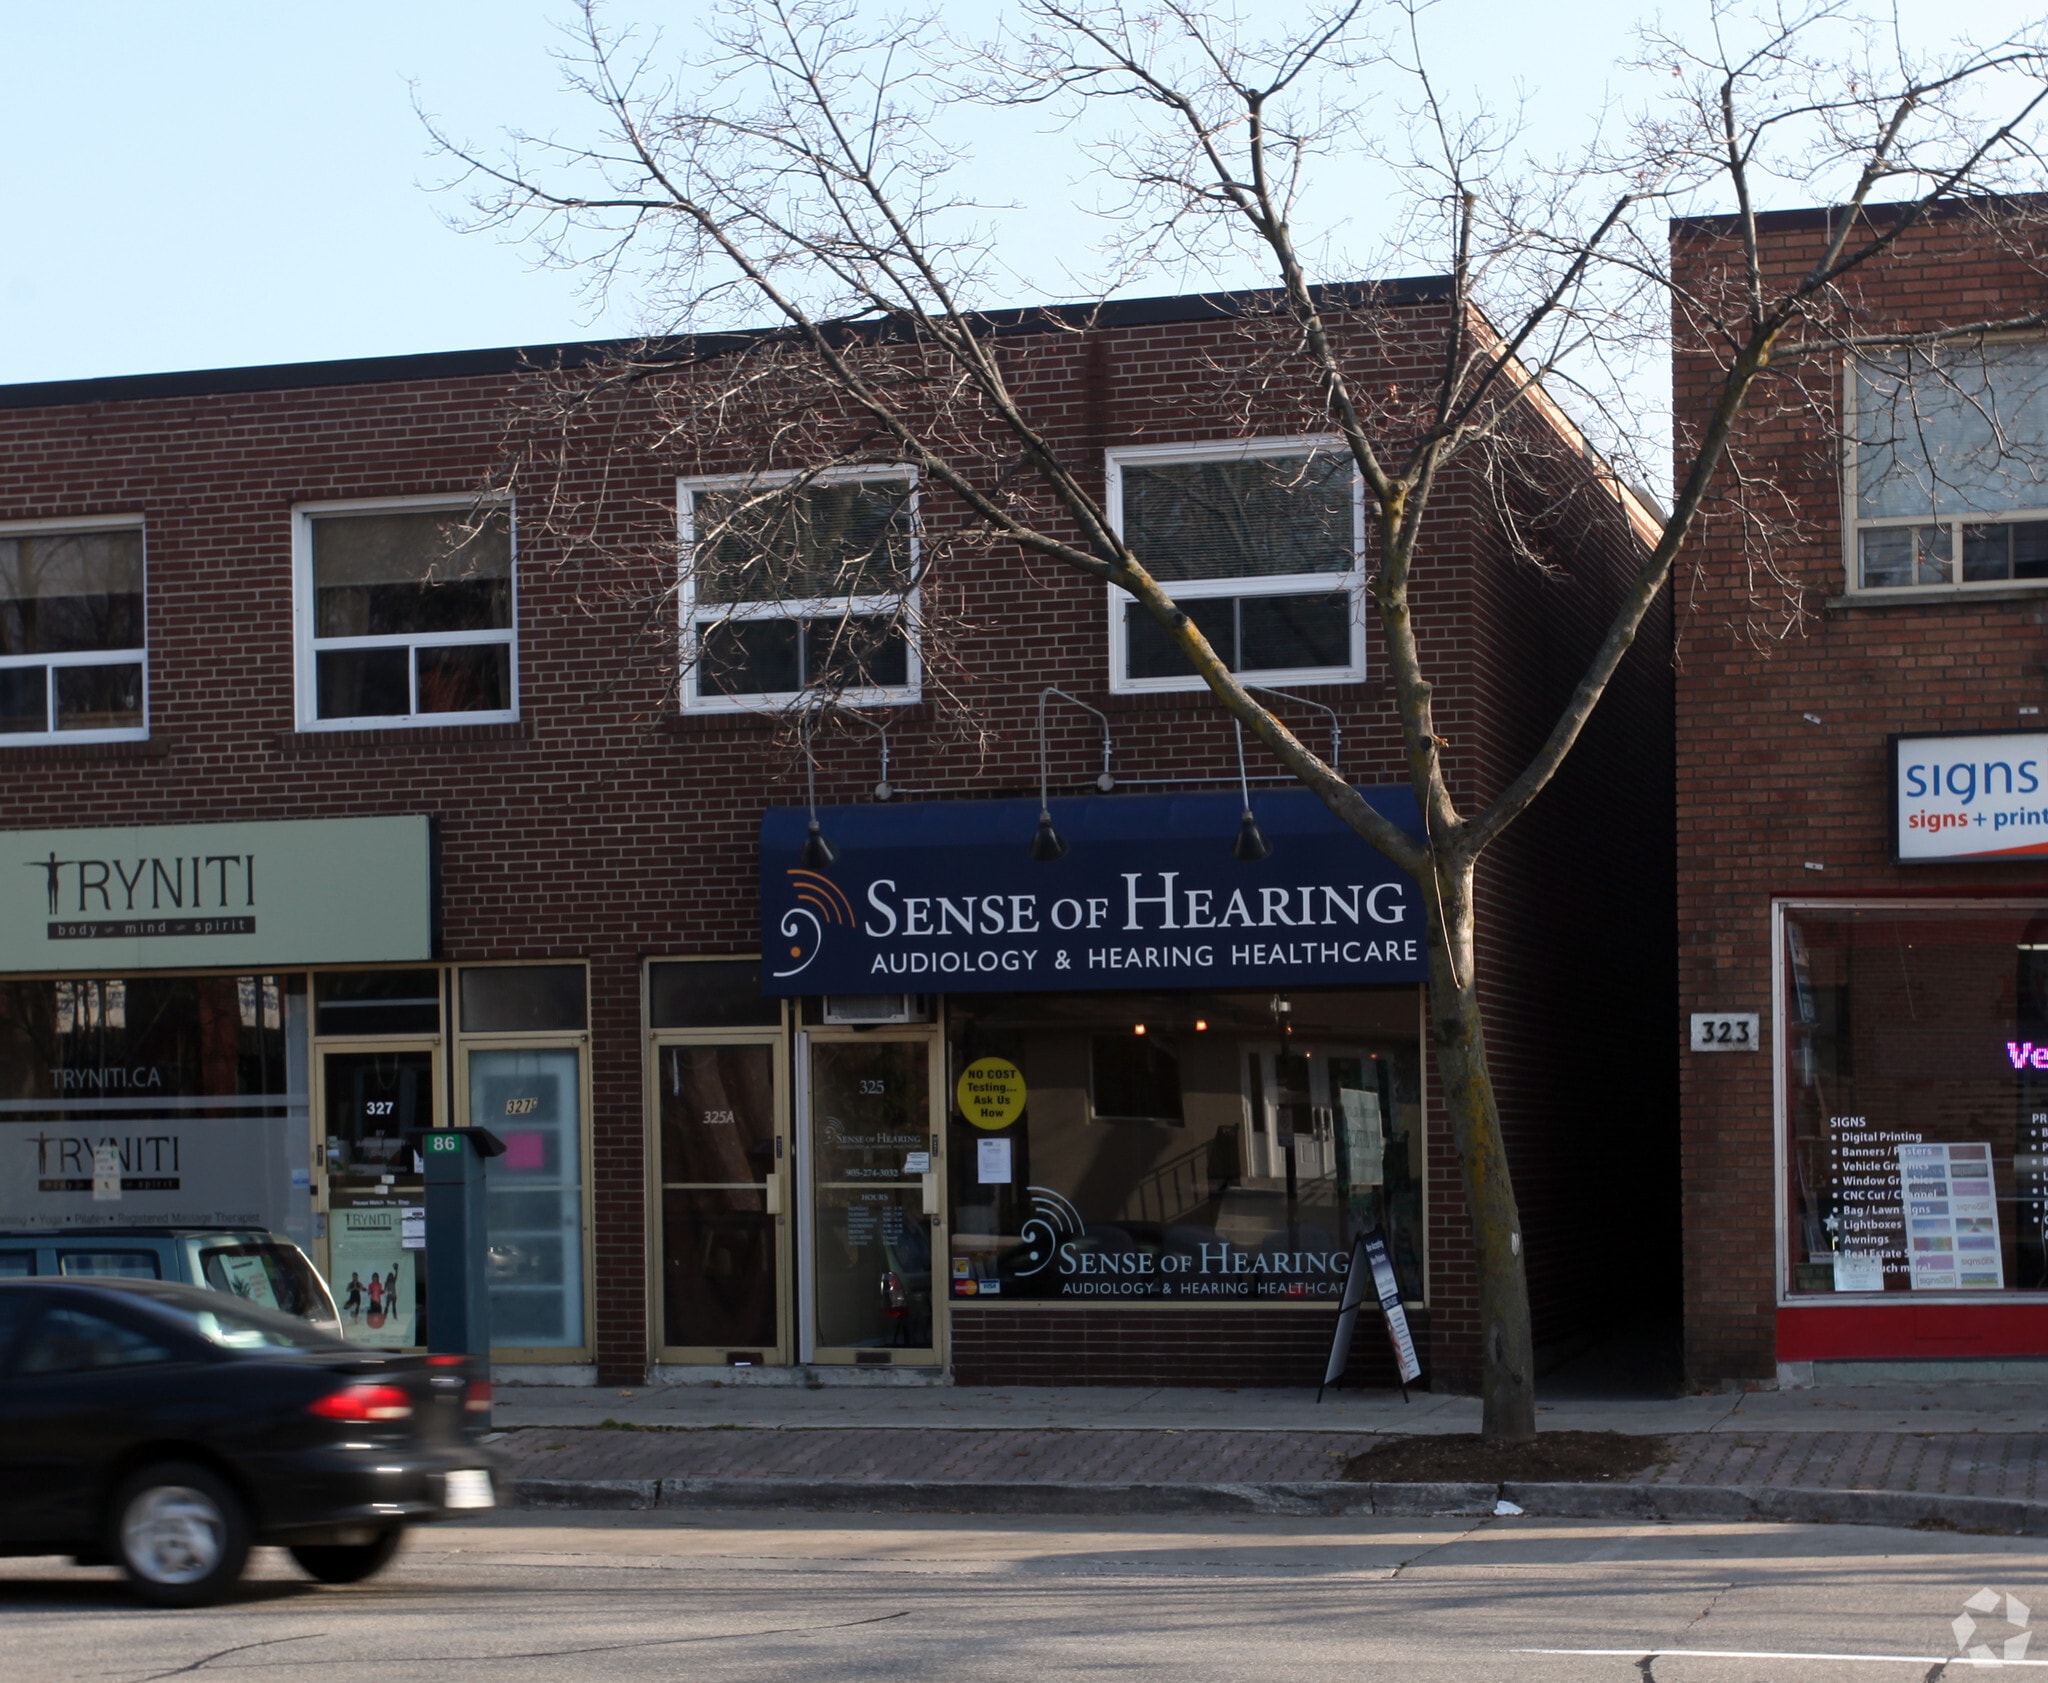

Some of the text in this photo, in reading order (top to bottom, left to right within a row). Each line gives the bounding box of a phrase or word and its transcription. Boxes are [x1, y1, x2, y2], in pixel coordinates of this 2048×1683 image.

[1909, 809, 1968, 833] signs
[23, 851, 255, 916] TRYNITI
[864, 871, 1407, 938] SENSE OF HEARING
[57, 919, 246, 939] body mind spirit
[870, 939, 1417, 975] AUDIOLOGY & HEARING HEALTHCARE
[1702, 1021, 1749, 1043] 323
[50, 1066, 162, 1089] TRYNITI.CA
[968, 1069, 1016, 1079] NO COST
[859, 1080, 885, 1095] 325
[967, 1083, 1017, 1093] Testing...
[974, 1096, 1011, 1104] Ask Us
[366, 1101, 394, 1116] 327
[981, 1108, 1004, 1117] How
[702, 1111, 735, 1124] 325A
[1830, 1117, 1866, 1128] SIGNS
[432, 1136, 456, 1152] 86
[835, 1133, 865, 1144] SENSE
[876, 1132, 921, 1144] HEARING
[1842, 1131, 1922, 1144] Digital Printing
[1842, 1147, 1885, 1157] Banners
[1893, 1146, 1933, 1156] Posters
[1843, 1161, 1881, 1171] Vehicle
[1843, 1175, 1886, 1186] Window
[1843, 1190, 1866, 1200] CNC
[1867, 1190, 1886, 1200] Cut
[1843, 1205, 1863, 1217] Bag
[1872, 1204, 1900, 1214] Lawn
[214, 1211, 261, 1225] Therapist
[1843, 1218, 1902, 1231] Lightboxes
[1843, 1234, 1890, 1246] Awnings
[1058, 1242, 1349, 1275] SENSE OF HEARING
[1844, 1249, 1868, 1258] Real
[1869, 1248, 1902, 1258] Estate
[1062, 1282, 1154, 1295] AUDIOLOGY
[1162, 1282, 1172, 1294] &
[1180, 1282, 1249, 1295] HEARING
